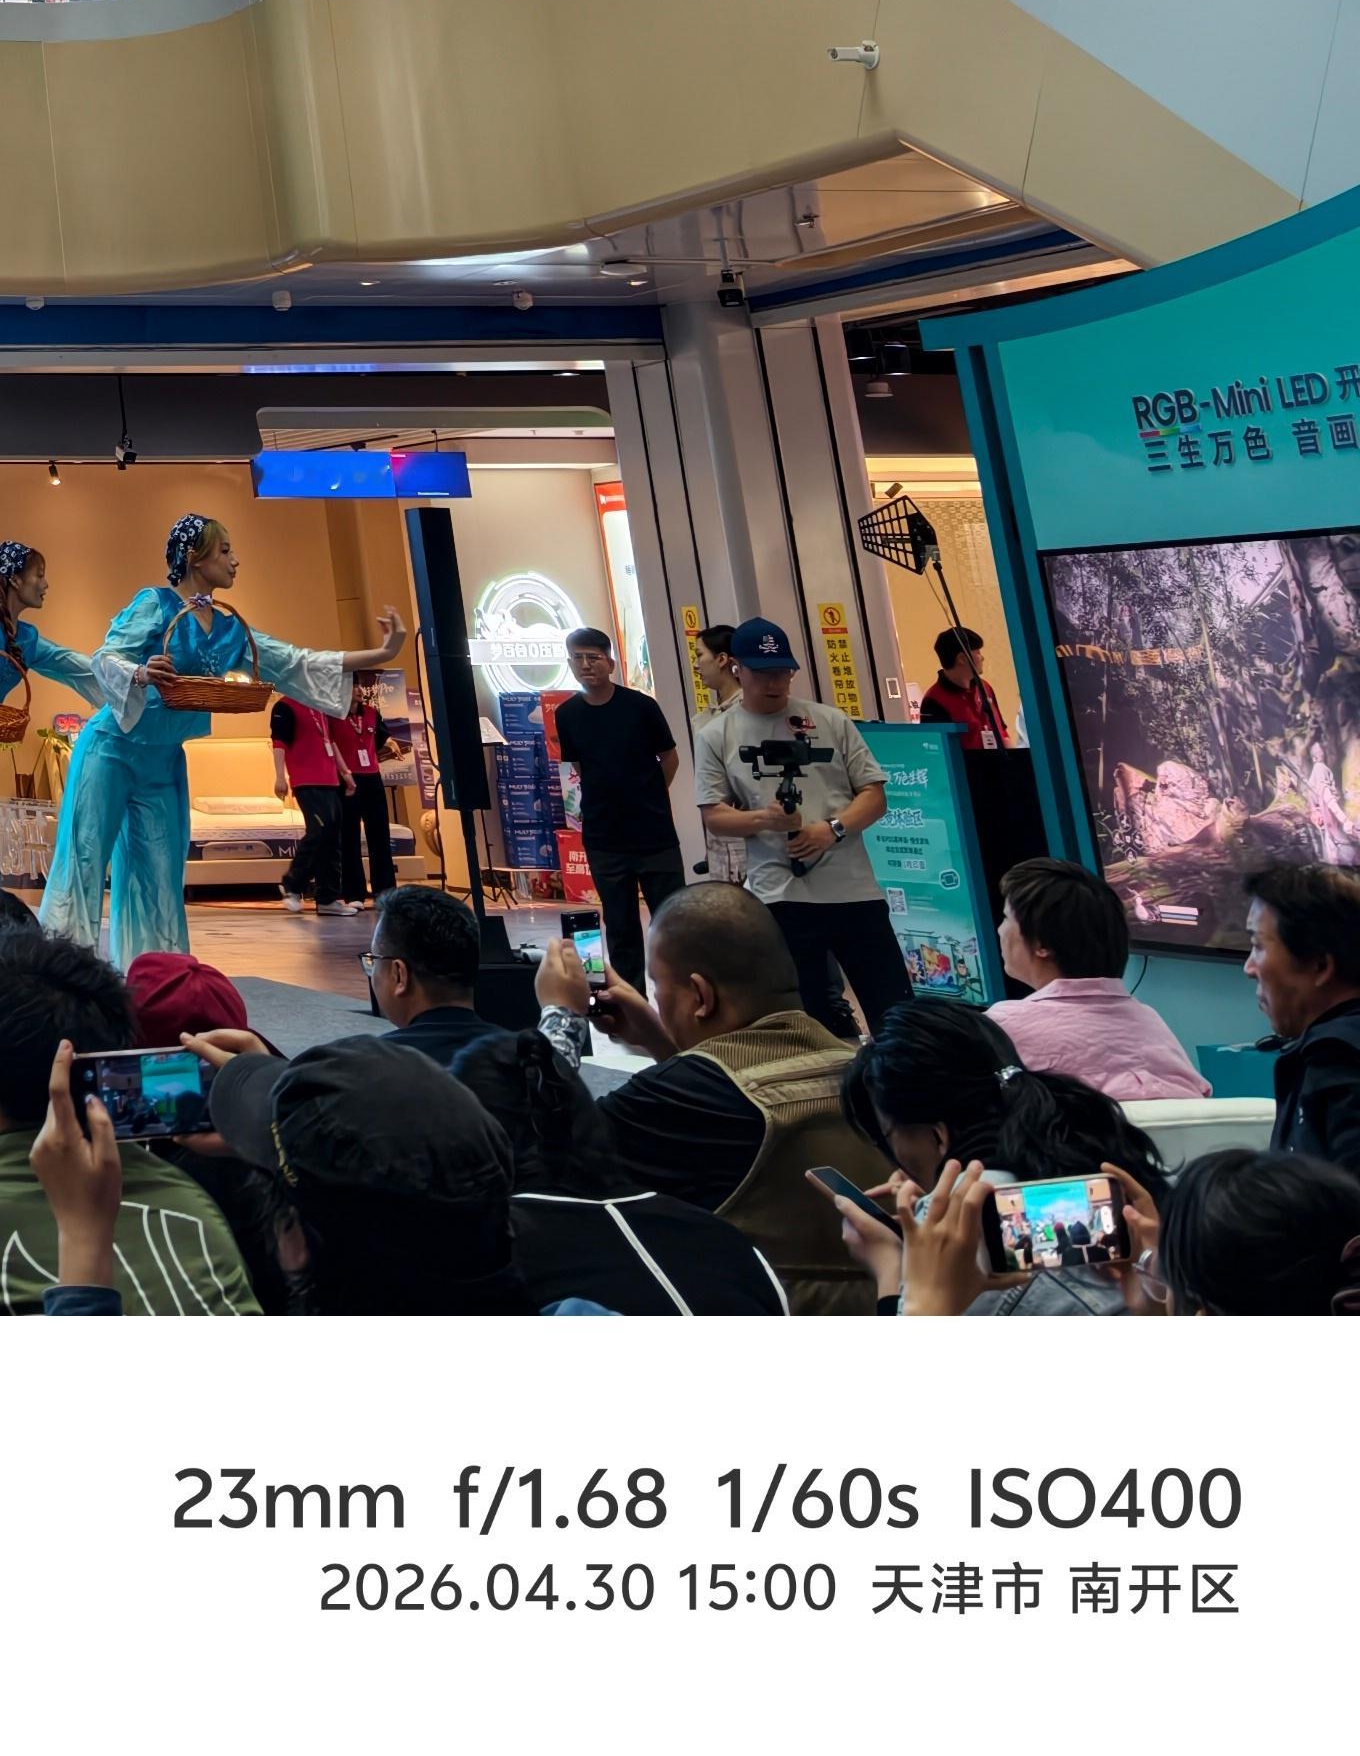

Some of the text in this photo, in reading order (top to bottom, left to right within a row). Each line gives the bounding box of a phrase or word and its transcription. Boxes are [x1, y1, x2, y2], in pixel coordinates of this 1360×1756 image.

[1131, 375, 1273, 430] RGB-Mini
[1275, 371, 1330, 409] LED
[1144, 412, 1360, 473] 三生万色 音画
[837, 638, 861, 717] 禁止堆放物品
